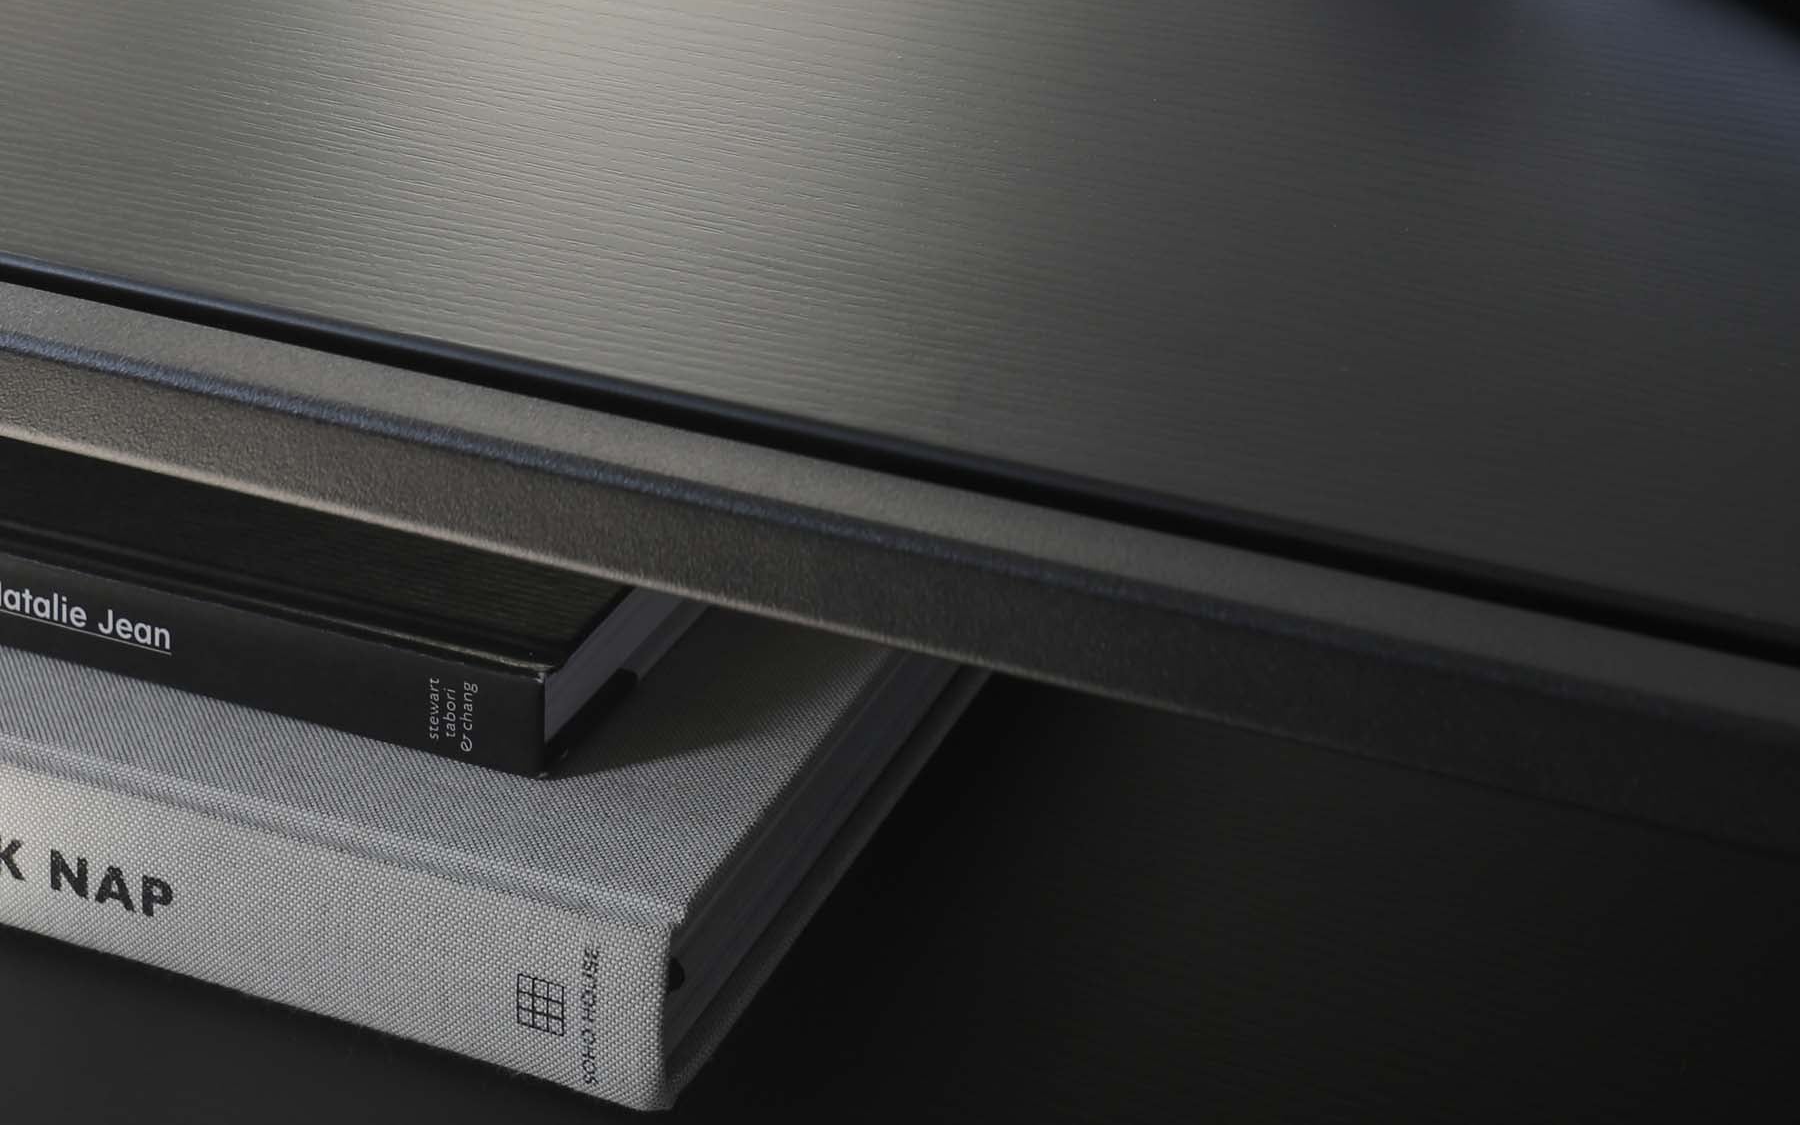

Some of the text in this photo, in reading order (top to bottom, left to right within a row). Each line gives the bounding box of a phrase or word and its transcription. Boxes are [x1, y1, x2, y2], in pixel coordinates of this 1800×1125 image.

[0, 580, 171, 650] atalie Jean
[429, 677, 440, 740] stewart
[443, 687, 456, 737] tabori
[460, 681, 478, 731] chang
[50, 848, 173, 916] NAP
[582, 948, 600, 1085] SOHO HOUSE
